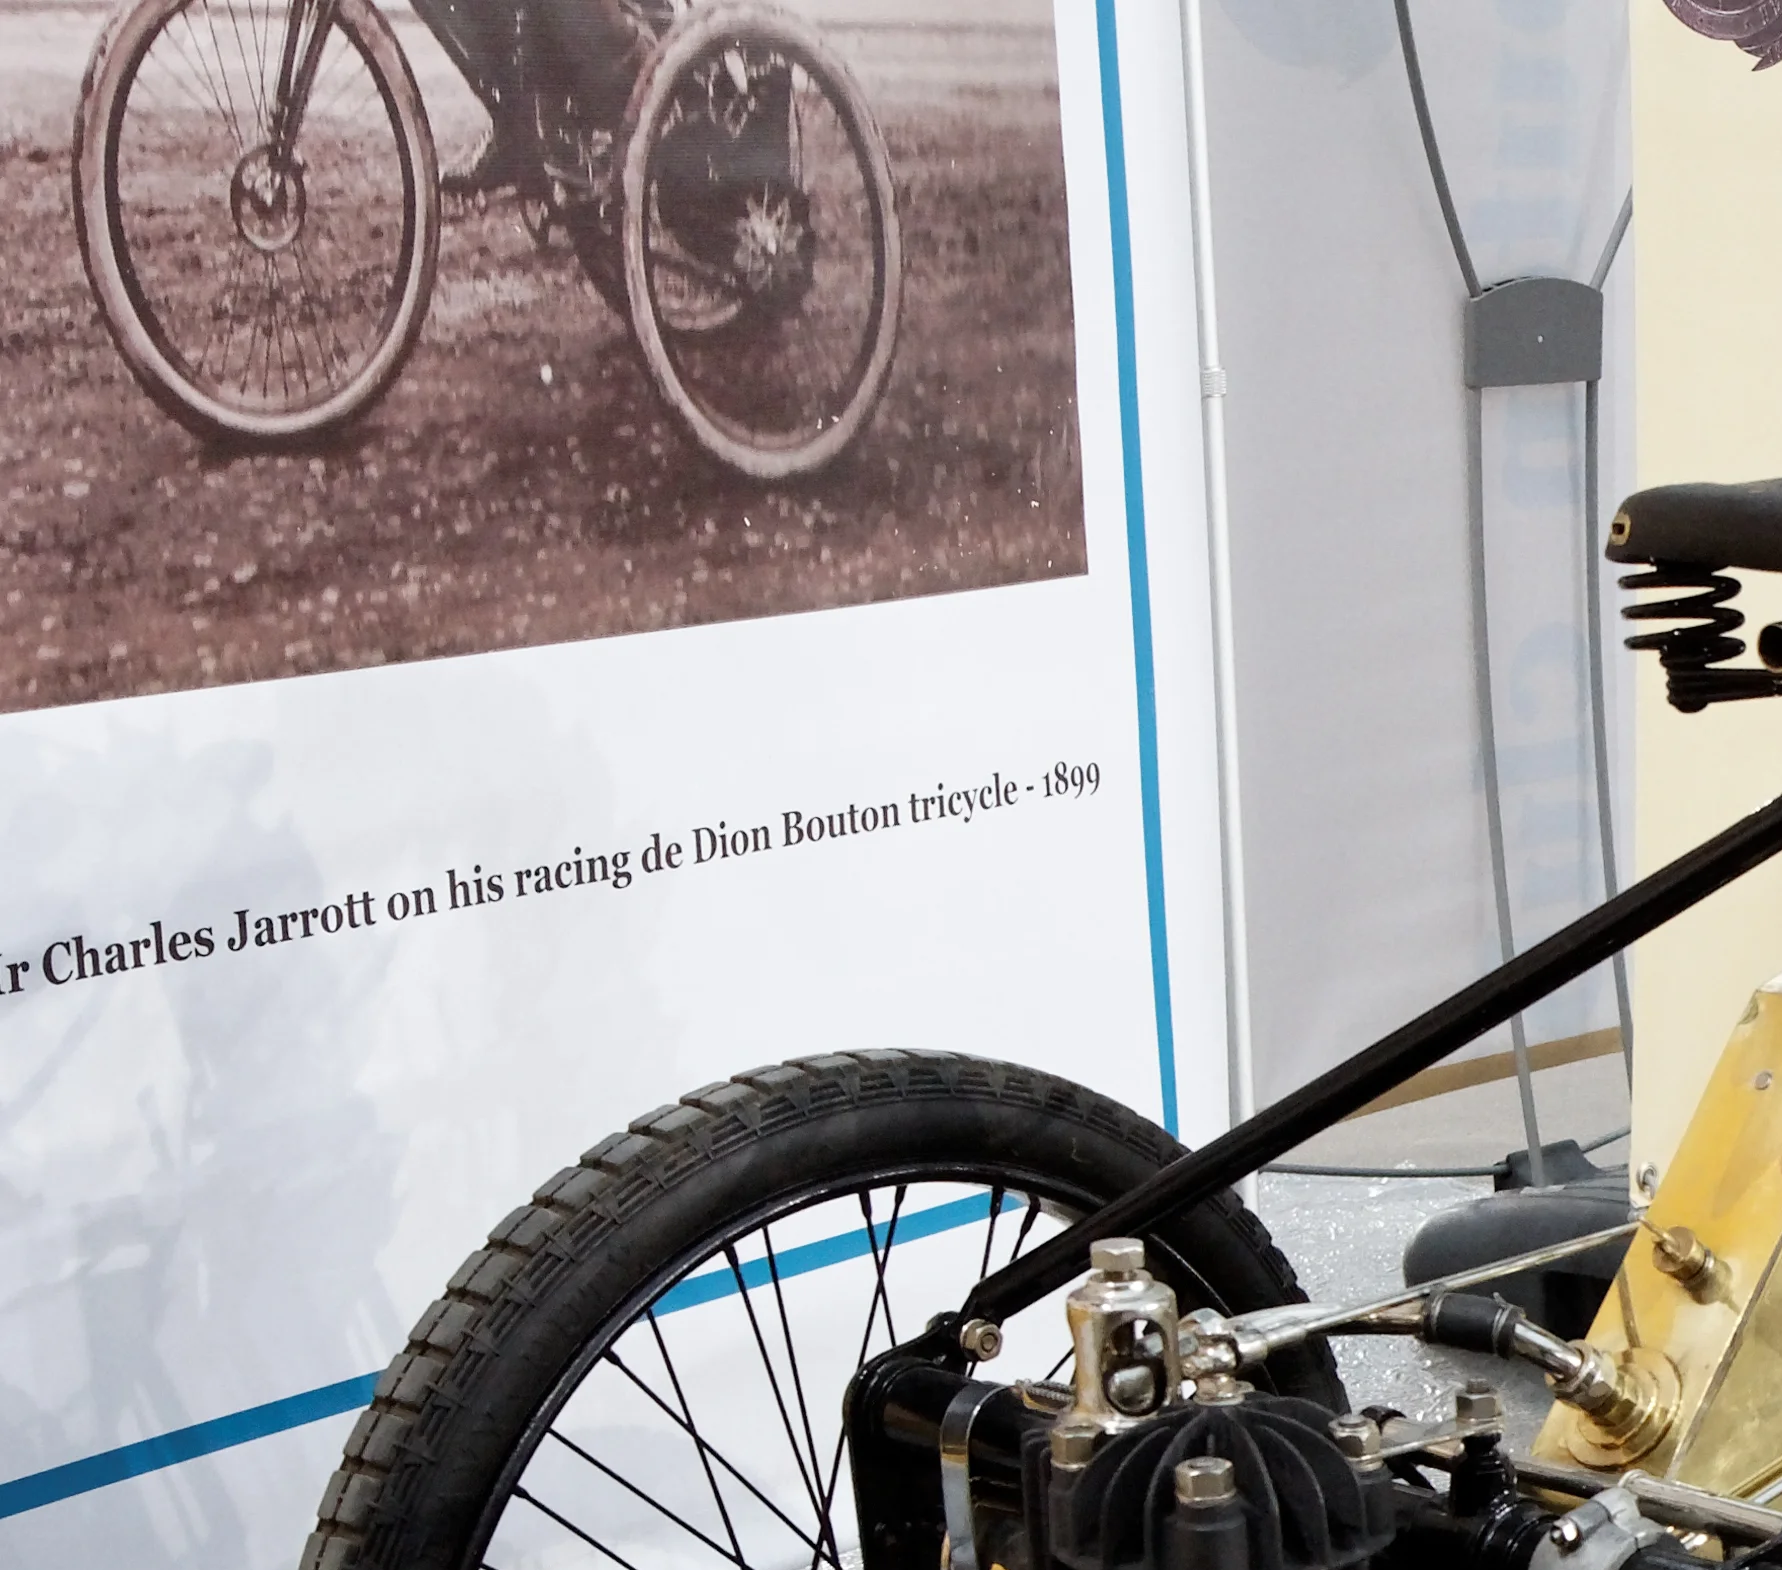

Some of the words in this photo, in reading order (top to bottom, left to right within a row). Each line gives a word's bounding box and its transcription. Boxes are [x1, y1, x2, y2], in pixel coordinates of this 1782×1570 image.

[0, 952, 31, 996] r
[42, 920, 215, 986] Charles
[227, 891, 377, 952] Jarrott
[387, 887, 438, 921] on
[446, 865, 505, 912] his
[513, 846, 633, 898] racing
[641, 832, 683, 874] de
[691, 819, 772, 864] Dion
[782, 793, 901, 847] Bouton
[909, 773, 1018, 824] tricycle
[1042, 761, 1102, 799] 1899
